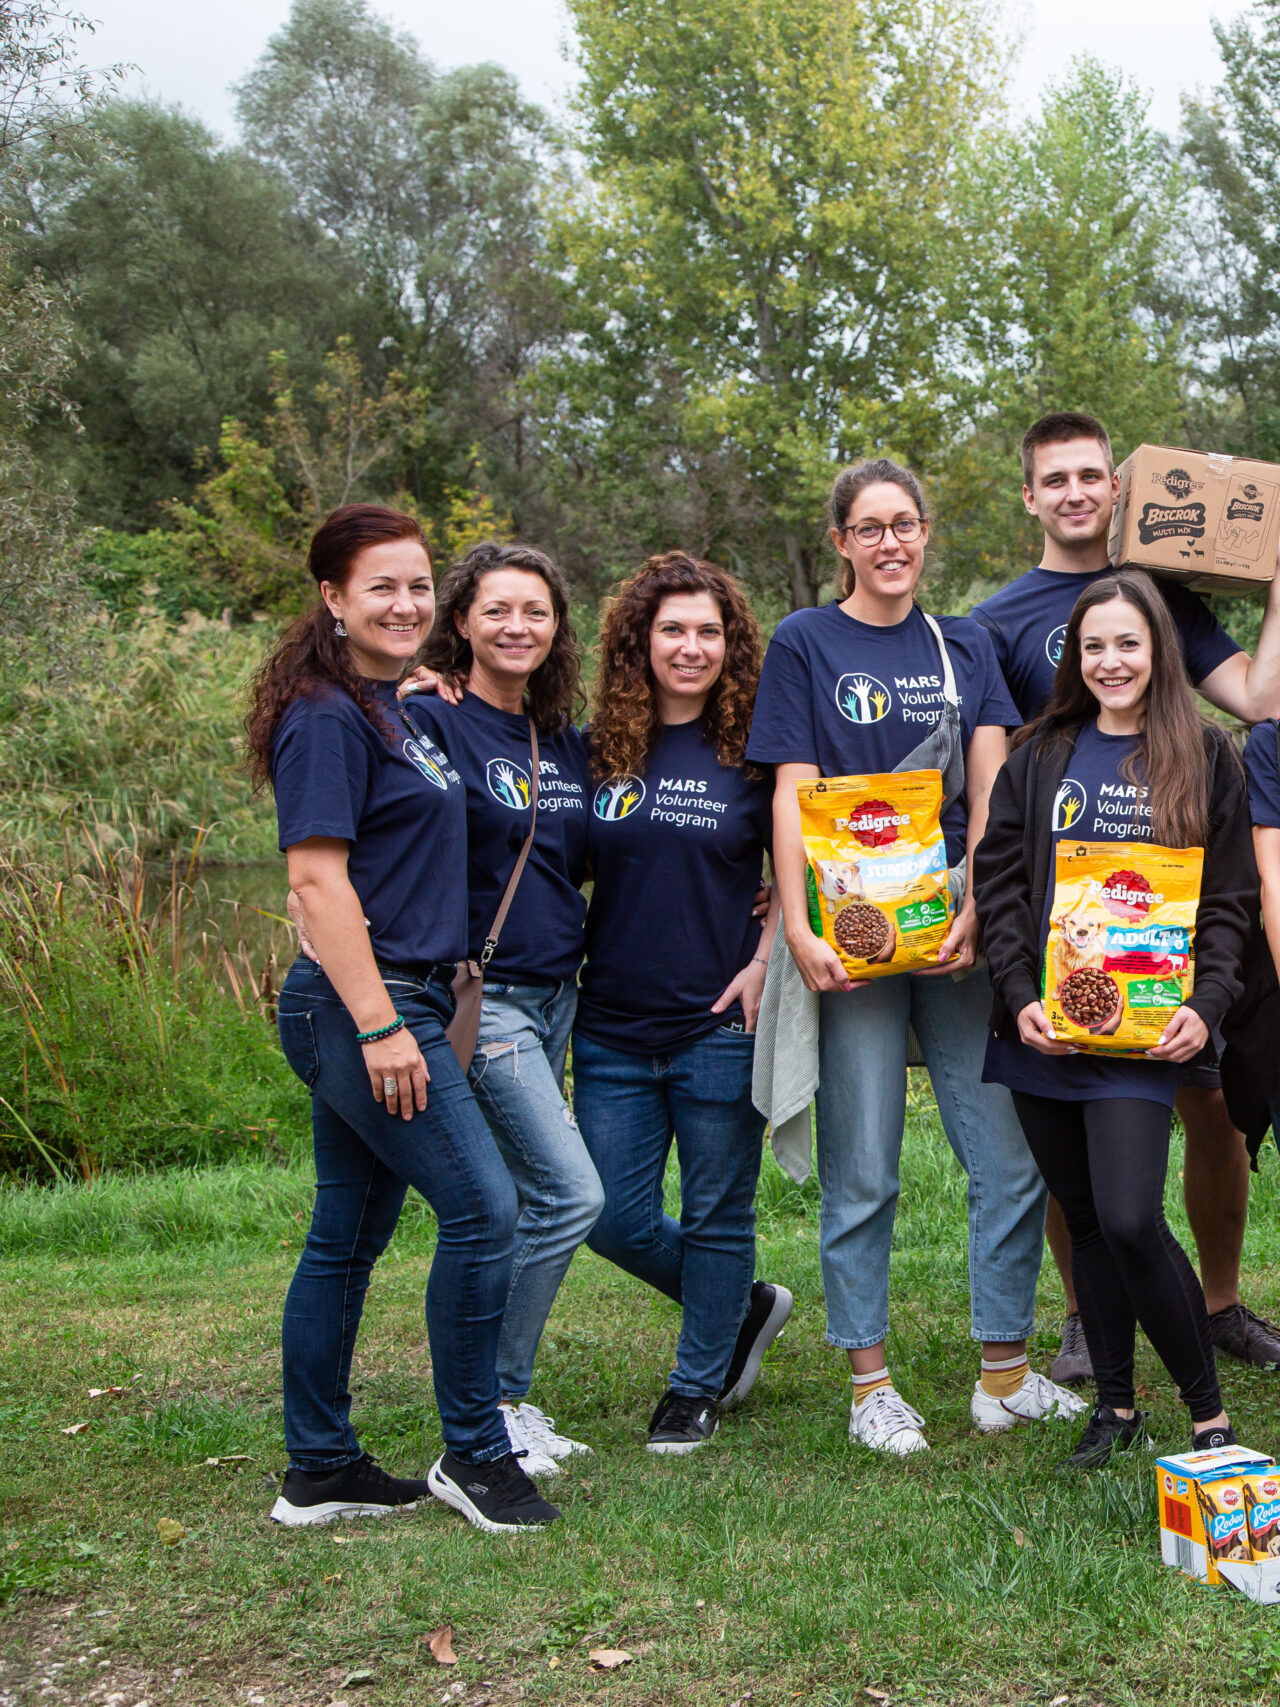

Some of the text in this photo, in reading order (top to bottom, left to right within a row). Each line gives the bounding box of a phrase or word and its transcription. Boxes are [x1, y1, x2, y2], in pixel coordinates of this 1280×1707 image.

[1152, 472, 1205, 490] Pedigree
[1145, 508, 1201, 525] BISCROK
[1152, 527, 1176, 537] MULTI
[894, 676, 941, 689] MARS
[658, 777, 708, 793] MARS
[1099, 783, 1150, 798] MARS
[537, 798, 583, 812] ogram
[655, 793, 728, 814] Volunteer
[1097, 800, 1154, 816] Volunte
[650, 808, 719, 830] Program
[835, 813, 911, 832] Pedigree
[1088, 879, 1164, 905] Pedigree
[1111, 928, 1171, 947] ADULT
[1051, 1011, 1056, 1019] 3
[1215, 1514, 1243, 1538] Rodeo
